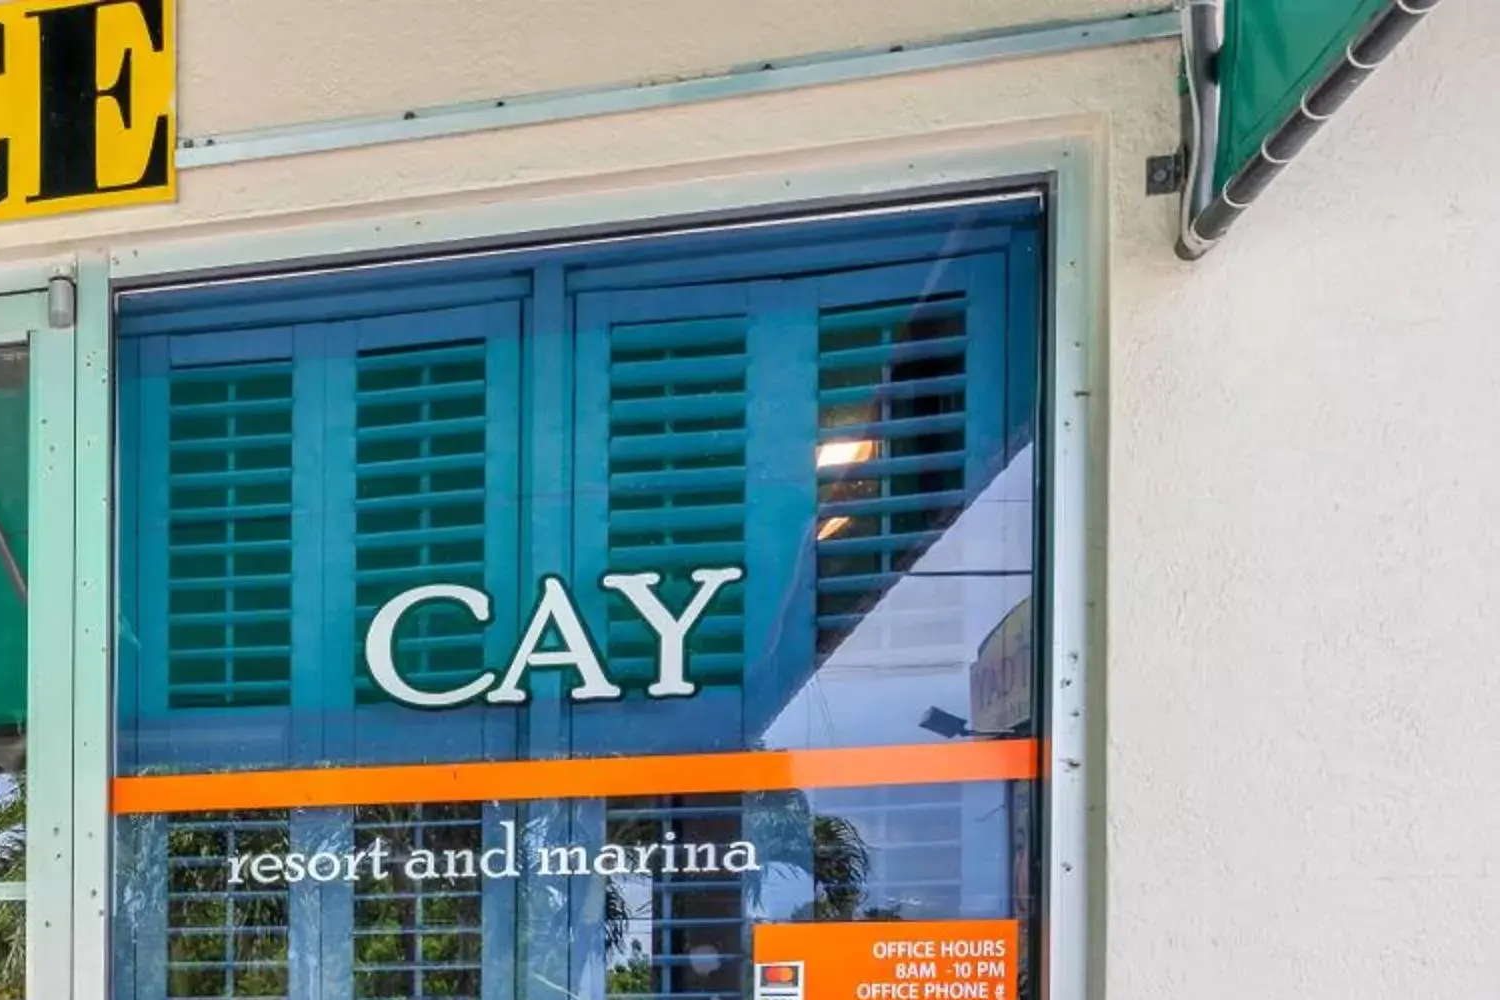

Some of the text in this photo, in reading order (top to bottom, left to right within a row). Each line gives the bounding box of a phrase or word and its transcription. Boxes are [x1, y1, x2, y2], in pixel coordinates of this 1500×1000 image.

[365, 567, 743, 706] CAY
[226, 821, 761, 885] resort and marina
[872, 939, 1005, 959] OFFICE HOURS
[895, 961, 937, 979] 8AM
[977, 960, 1005, 978] PM
[856, 982, 919, 1000] OFFICE
[924, 981, 989, 1000] PHONE
